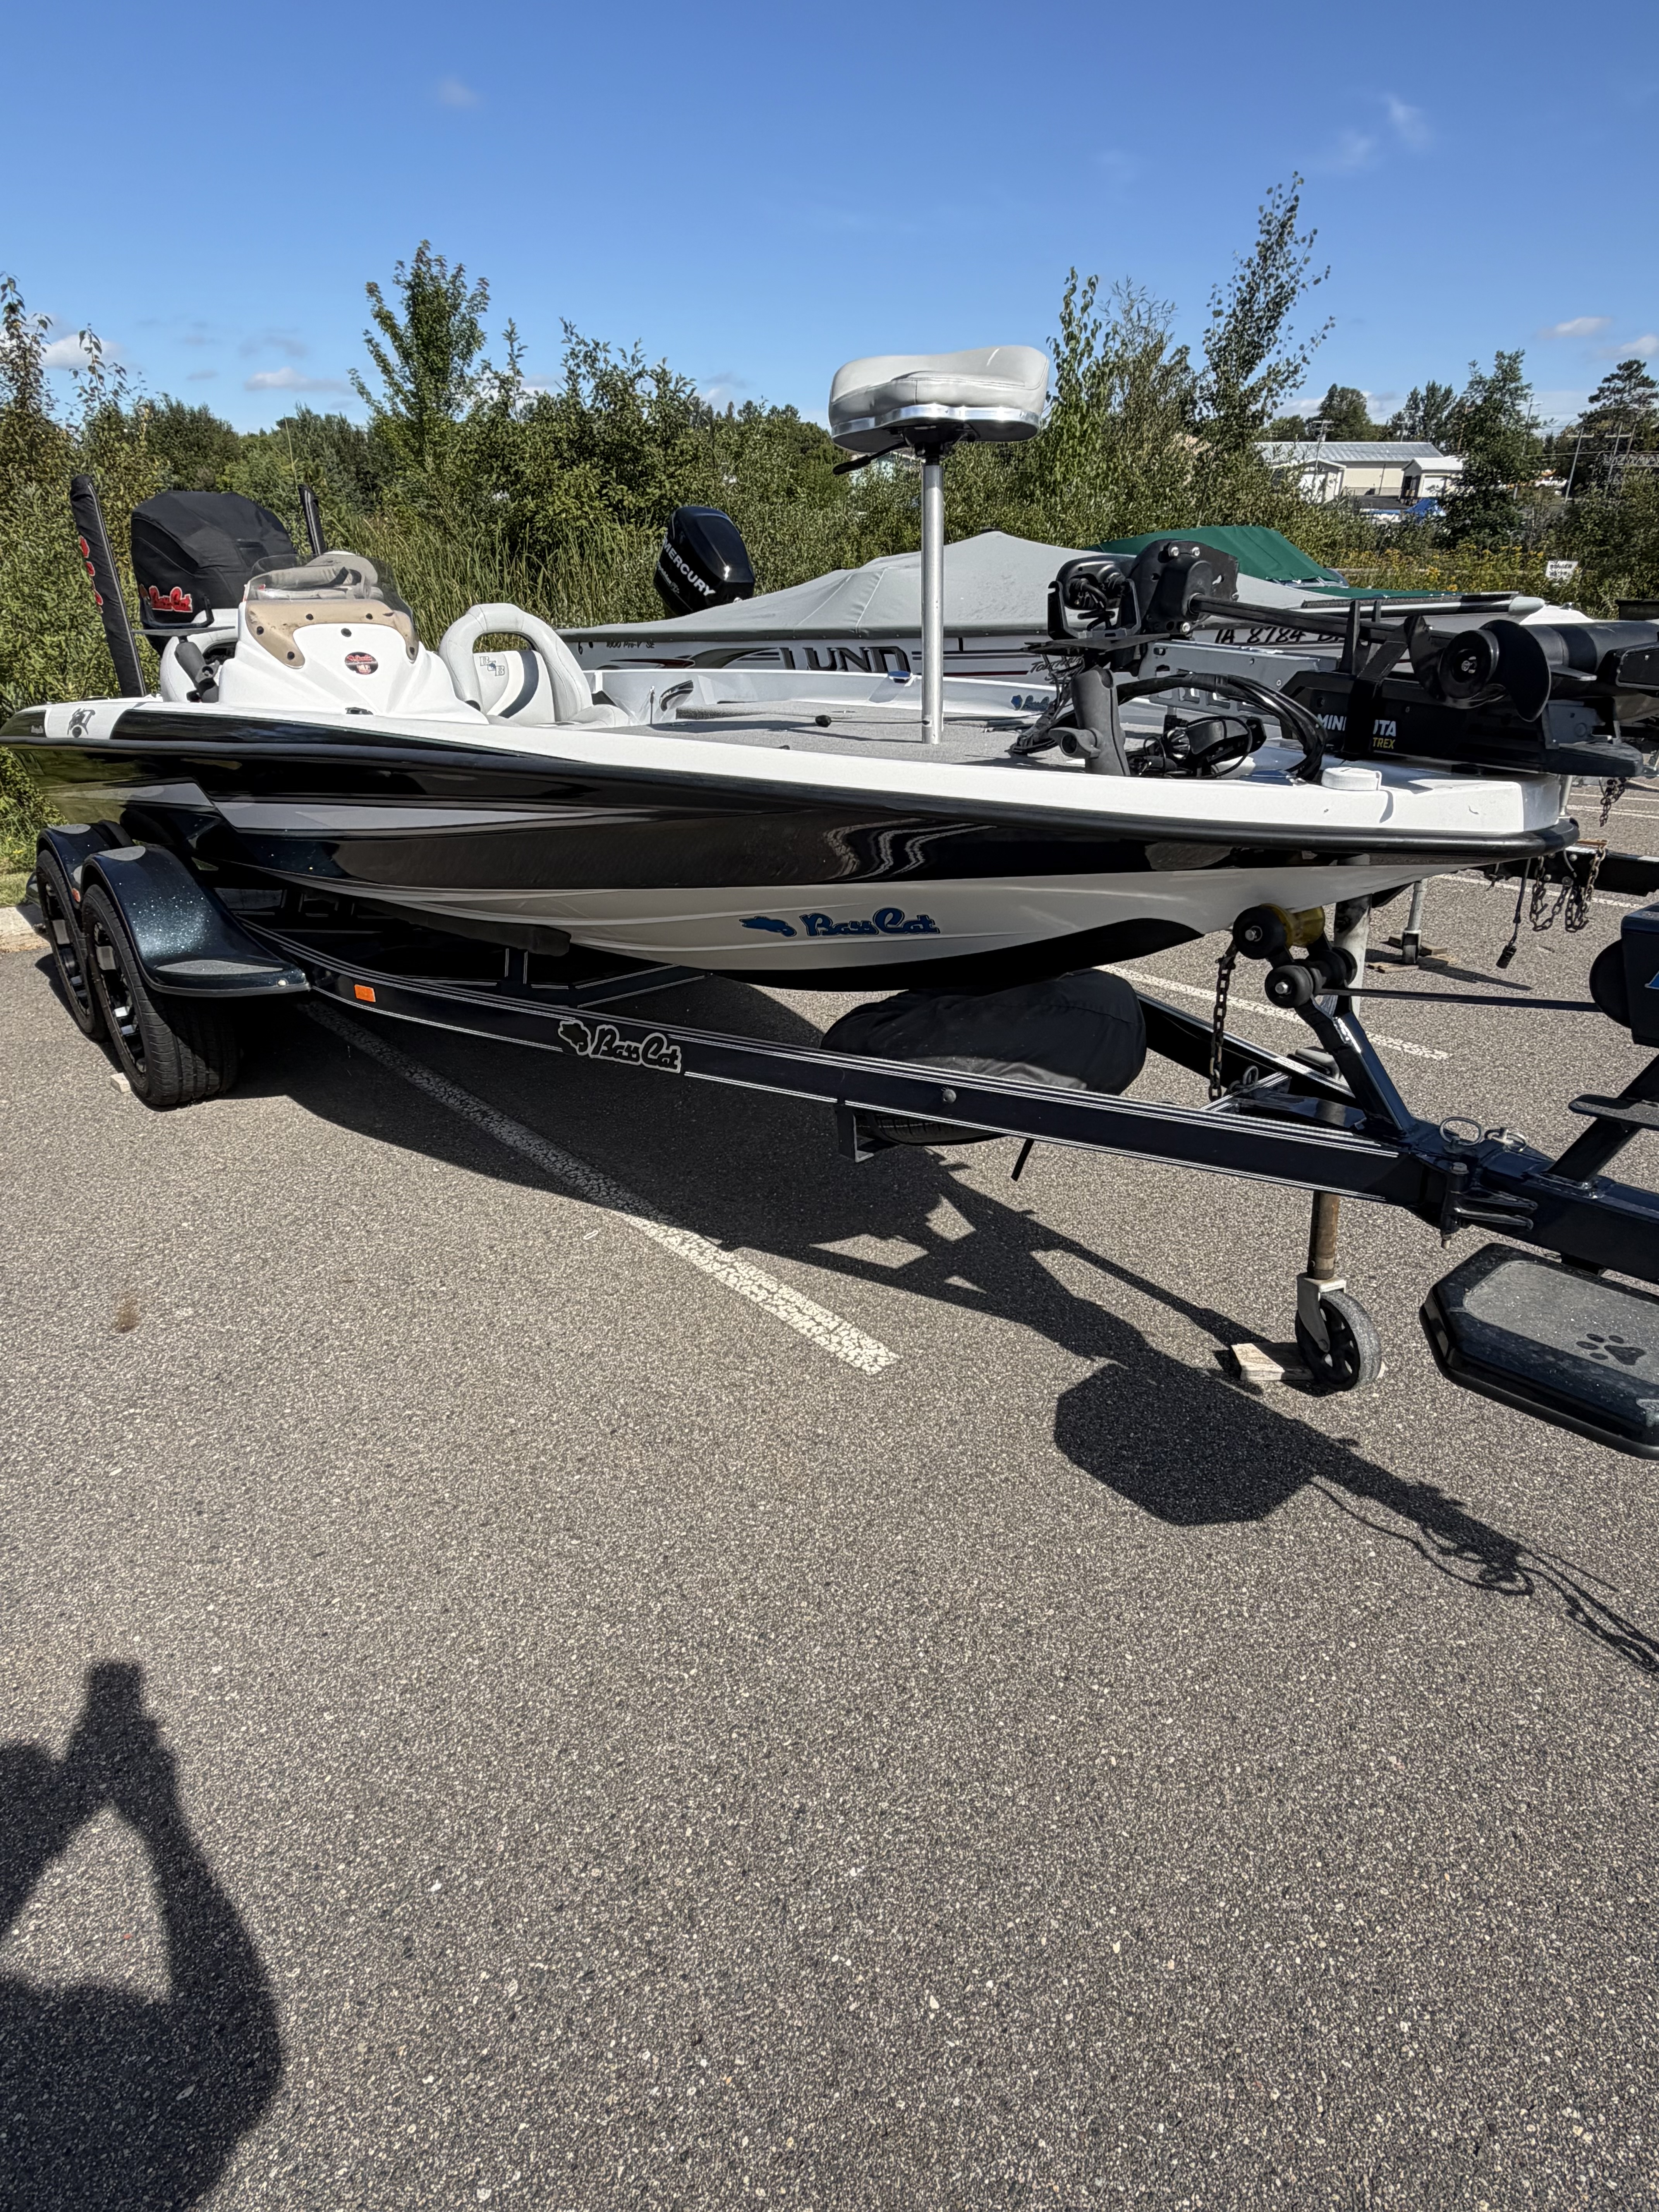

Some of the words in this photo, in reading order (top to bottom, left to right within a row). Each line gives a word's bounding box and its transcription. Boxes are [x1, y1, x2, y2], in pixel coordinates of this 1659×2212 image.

[663, 537, 716, 596] MERCURY
[1215, 629, 1235, 644] IA
[1247, 626, 1306, 645] 8784
[779, 646, 911, 673] LUND
[1372, 737, 1396, 749] TREX
[799, 912, 879, 936] Bass
[872, 907, 941, 934] Cat
[590, 1025, 641, 1064] Bass
[641, 1034, 680, 1072] Cat
